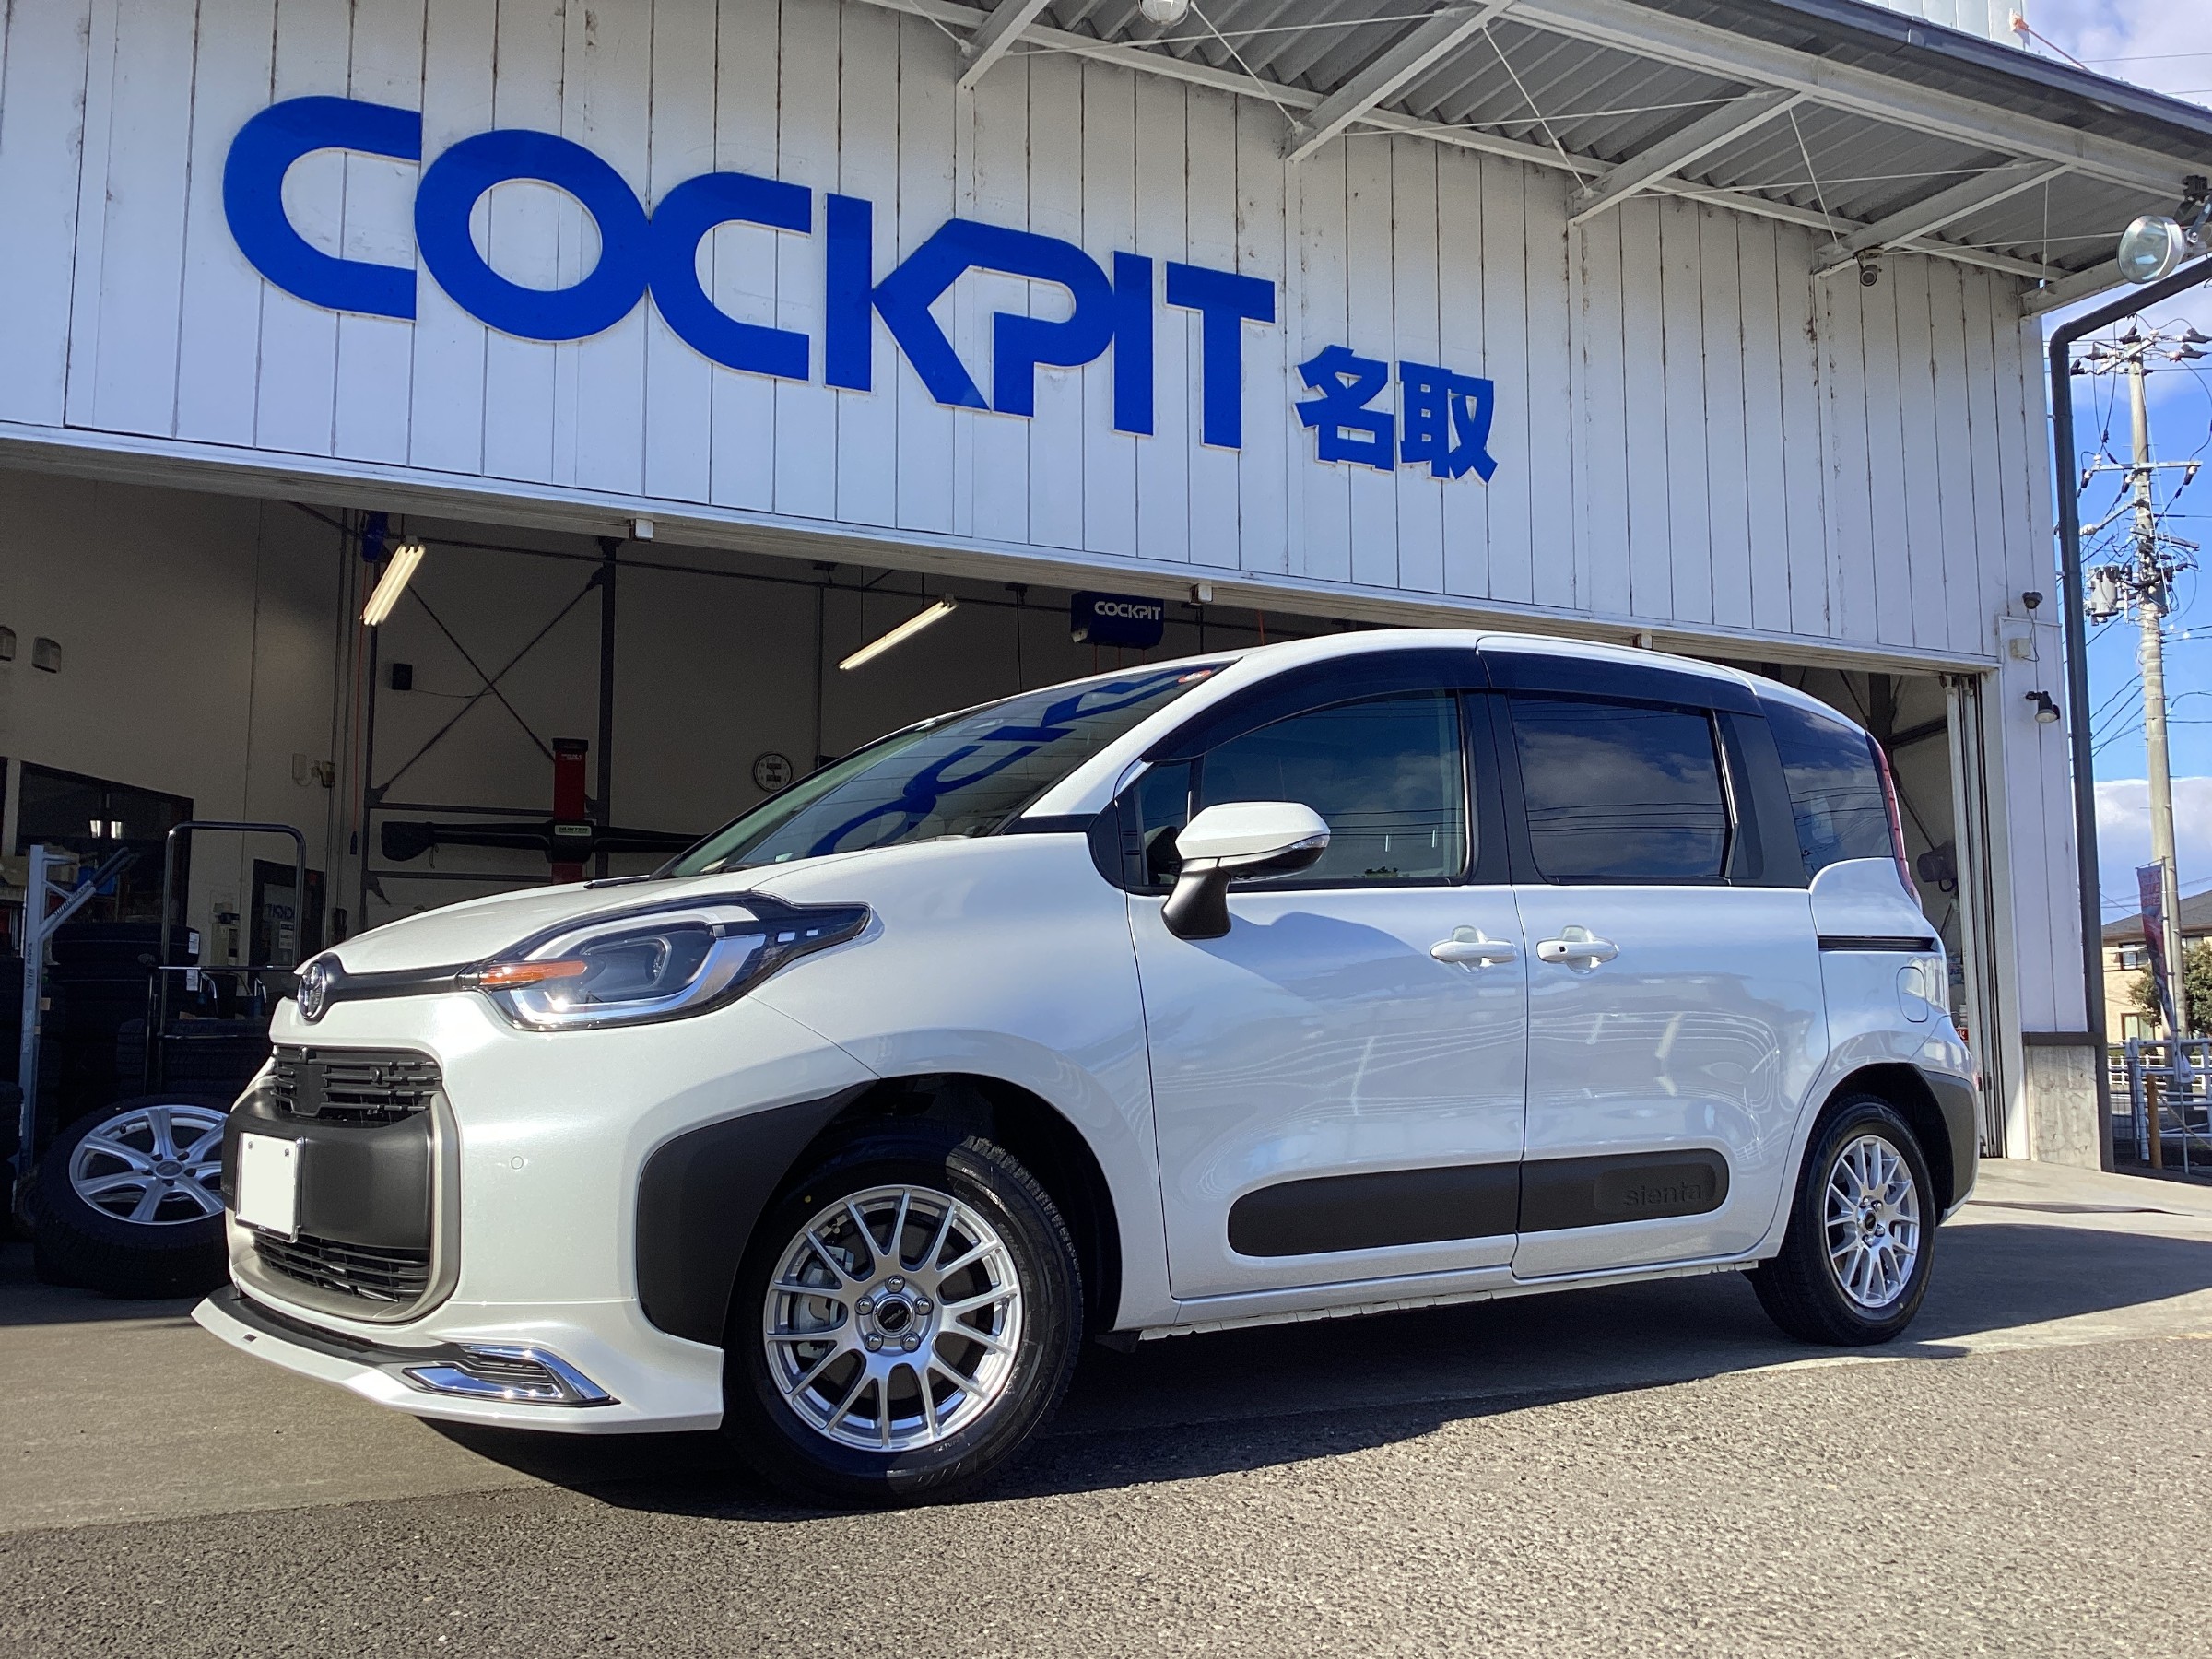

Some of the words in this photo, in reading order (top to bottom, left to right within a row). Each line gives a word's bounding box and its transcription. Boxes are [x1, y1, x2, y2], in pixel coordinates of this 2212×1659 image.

[222, 95, 1275, 450] COCKPIT
[1294, 345, 1499, 485] 名取
[1094, 600, 1161, 621] COCKPIT
[1623, 1181, 1701, 1206] sienta
